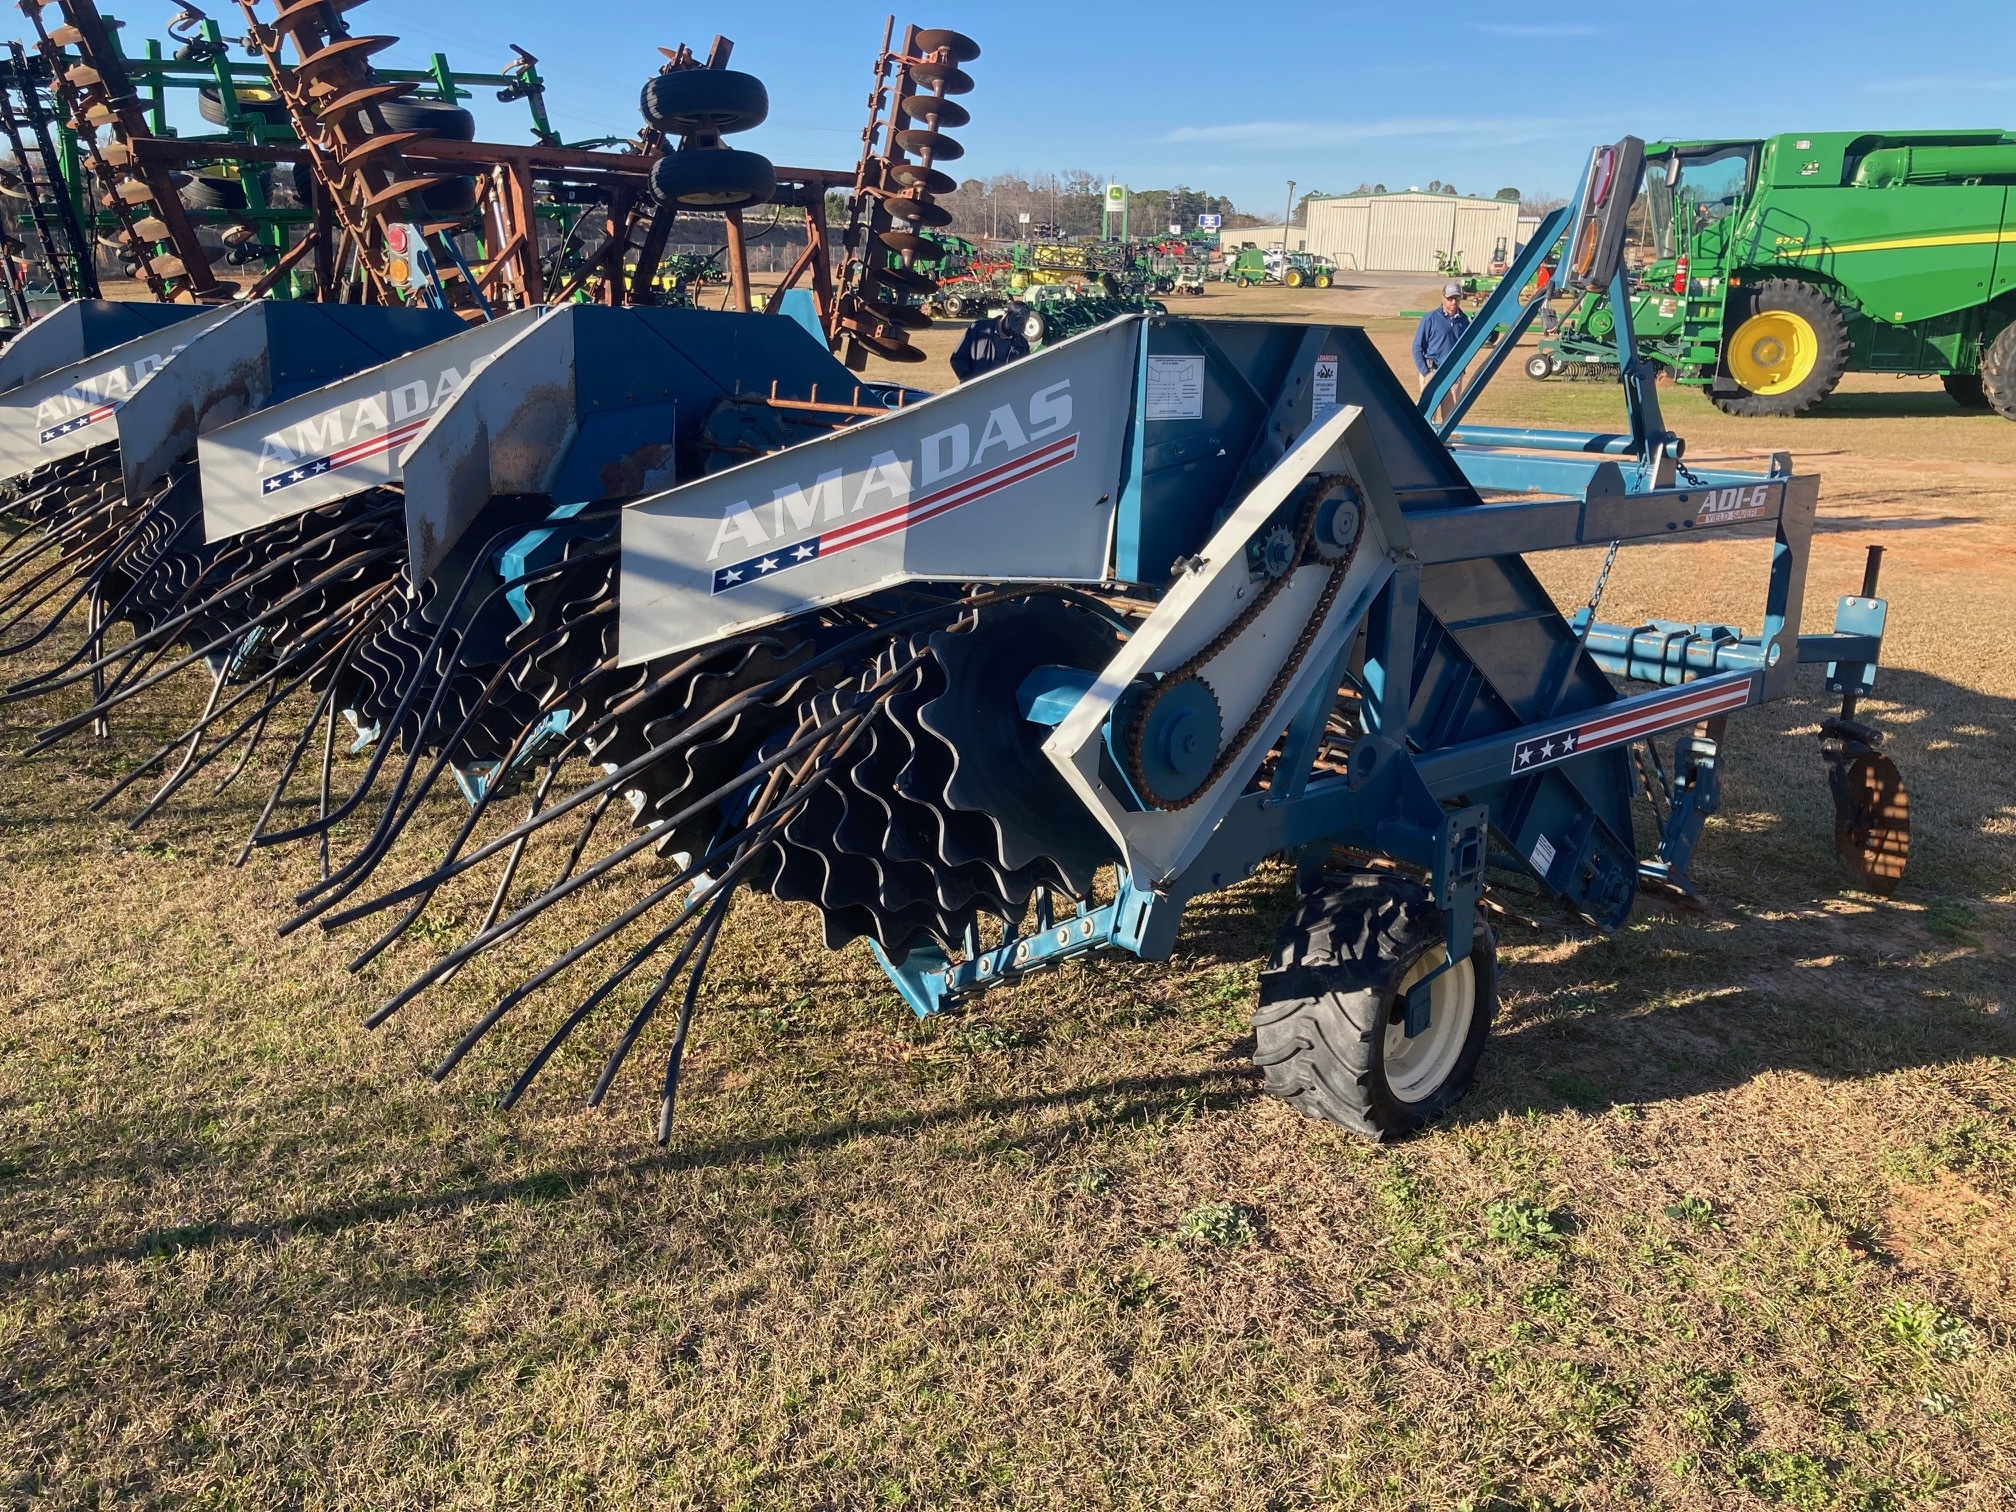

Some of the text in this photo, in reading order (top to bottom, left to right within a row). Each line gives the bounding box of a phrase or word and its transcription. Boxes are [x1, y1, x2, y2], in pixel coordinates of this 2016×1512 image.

[35, 344, 188, 429] AMAD
[1319, 354, 1338, 362] DANGER
[256, 355, 488, 475] AMADA
[706, 378, 1073, 562] AMADAS
[1698, 484, 1769, 514] ADI-6
[1707, 509, 1757, 523] YIELD SAVER
